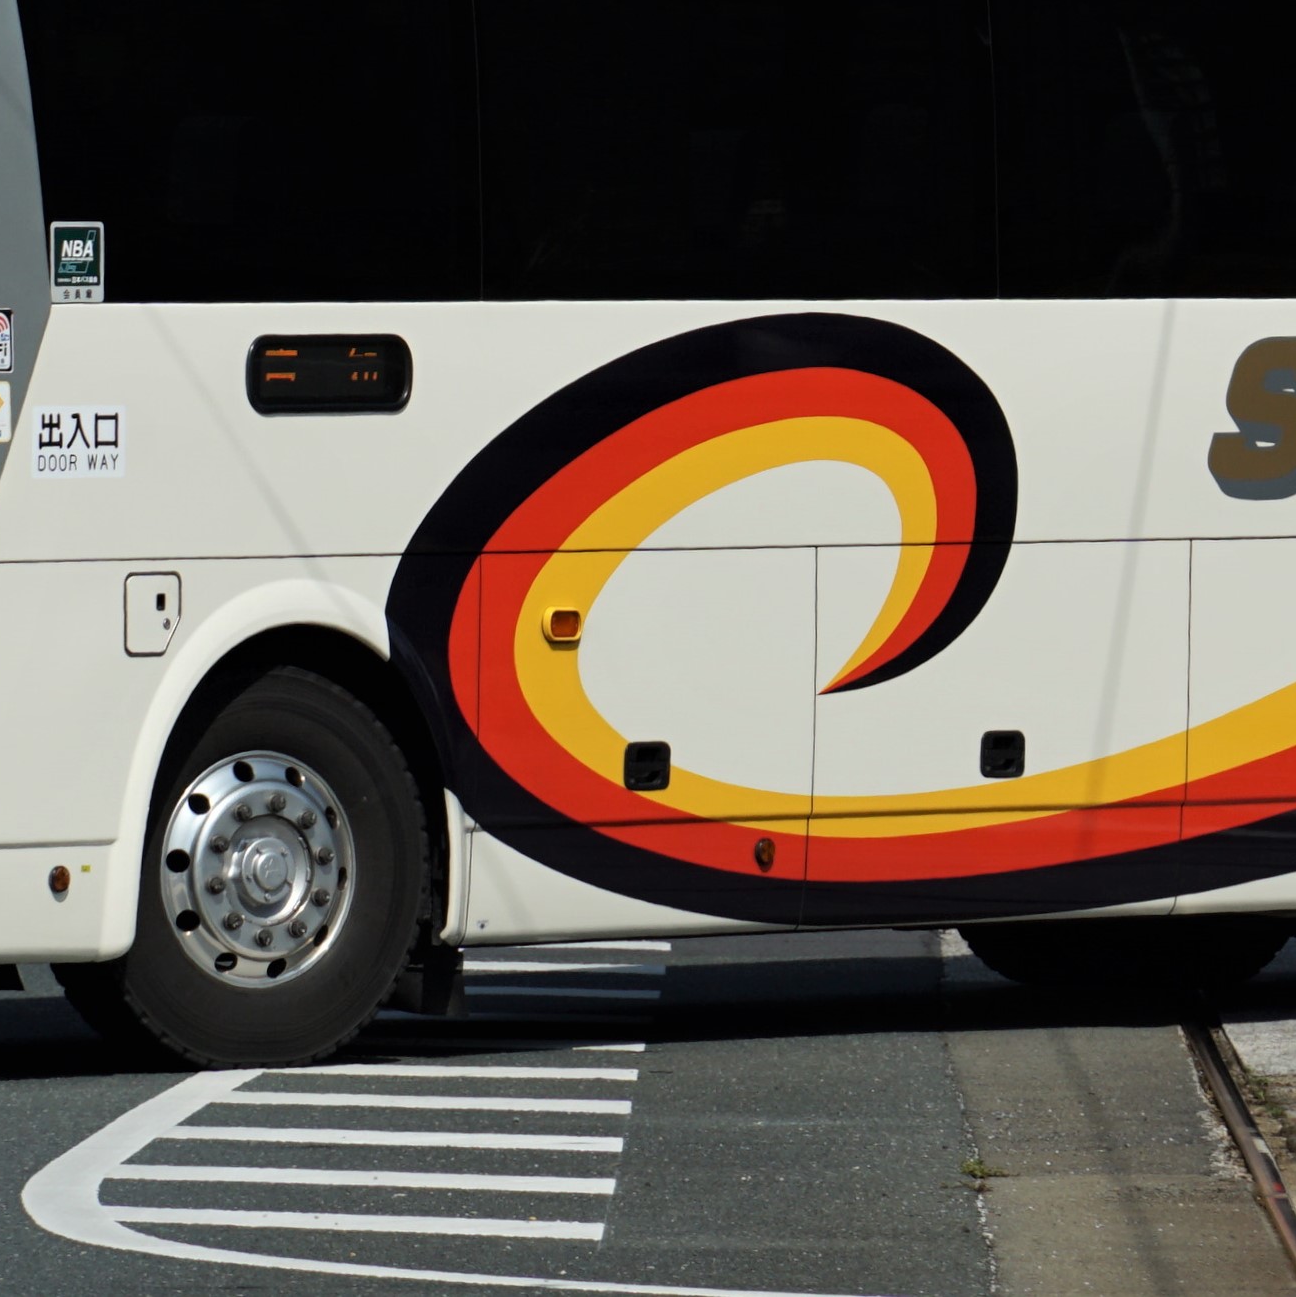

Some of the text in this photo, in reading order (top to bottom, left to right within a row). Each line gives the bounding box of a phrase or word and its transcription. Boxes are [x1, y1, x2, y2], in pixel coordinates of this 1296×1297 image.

[61, 239, 94, 257] NBA
[39, 412, 118, 449] 出入口
[38, 453, 119, 472] DOOR WAY
